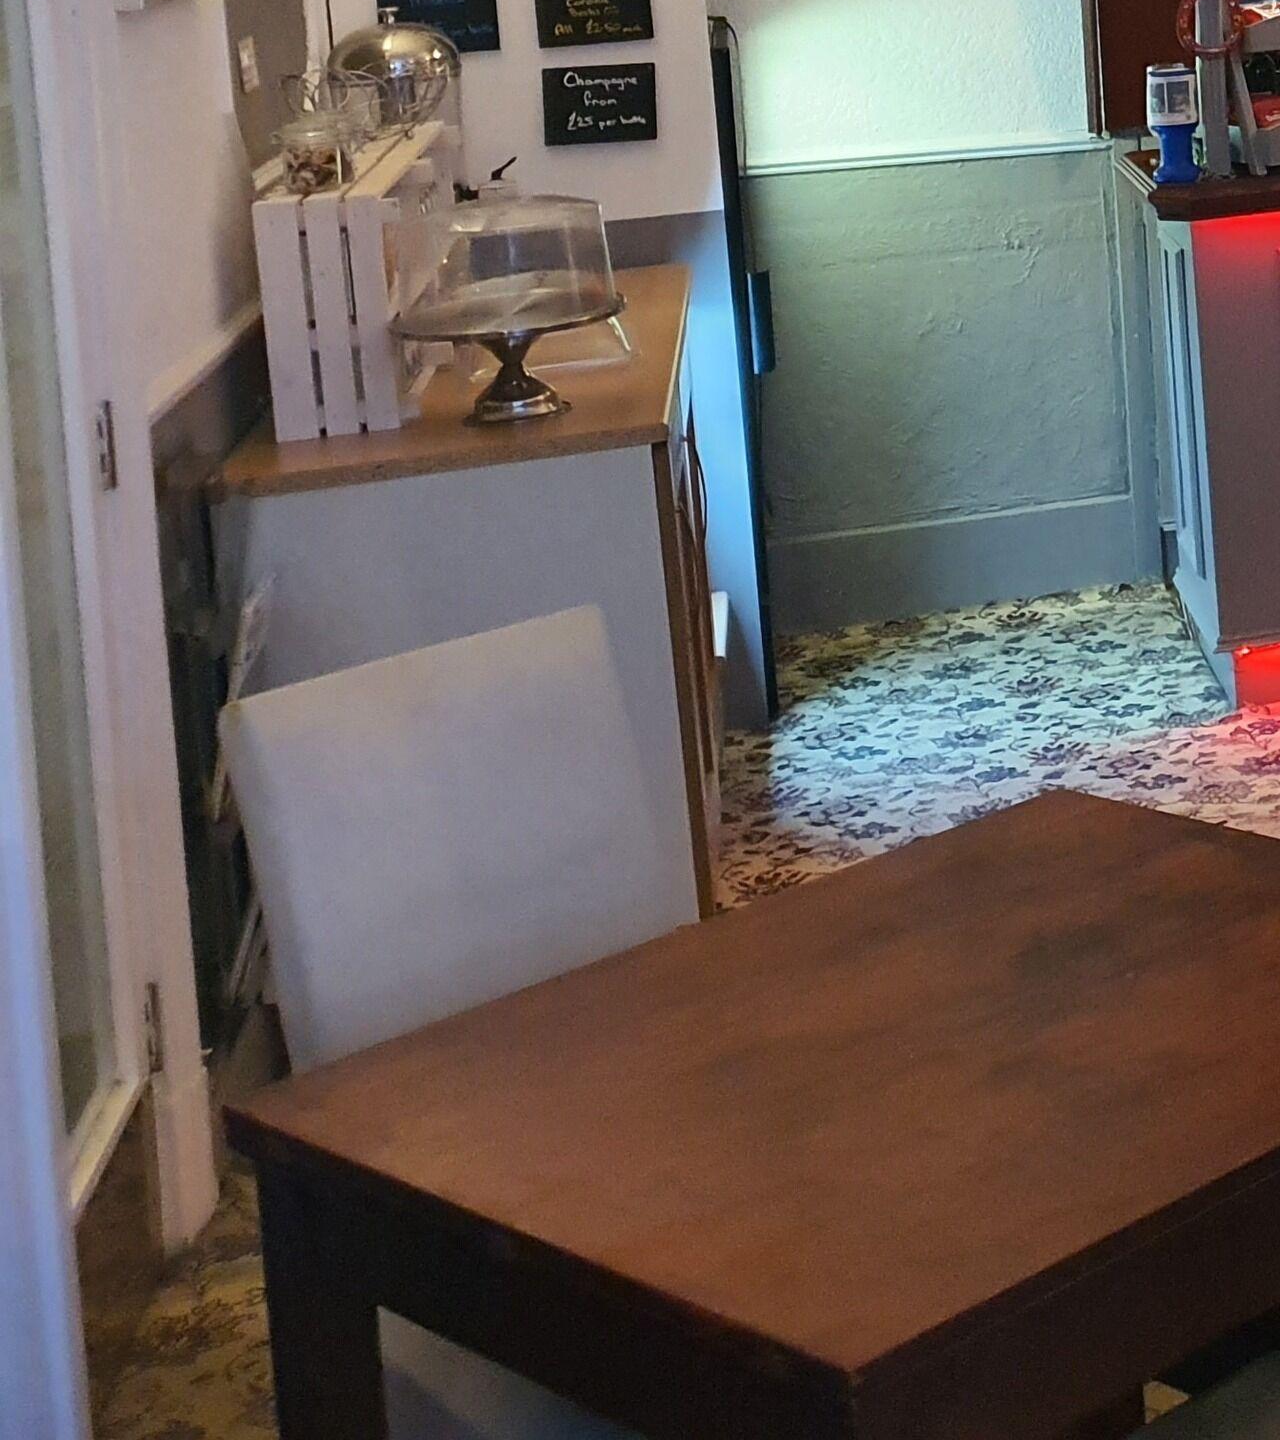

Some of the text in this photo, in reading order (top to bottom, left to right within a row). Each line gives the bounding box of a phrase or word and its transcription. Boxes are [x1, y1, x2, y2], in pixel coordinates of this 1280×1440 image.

[554, 23, 574, 36] All
[563, 71, 638, 91] Champagne
[583, 90, 617, 107] from
[567, 111, 594, 131] £25
[598, 119, 617, 130] per
